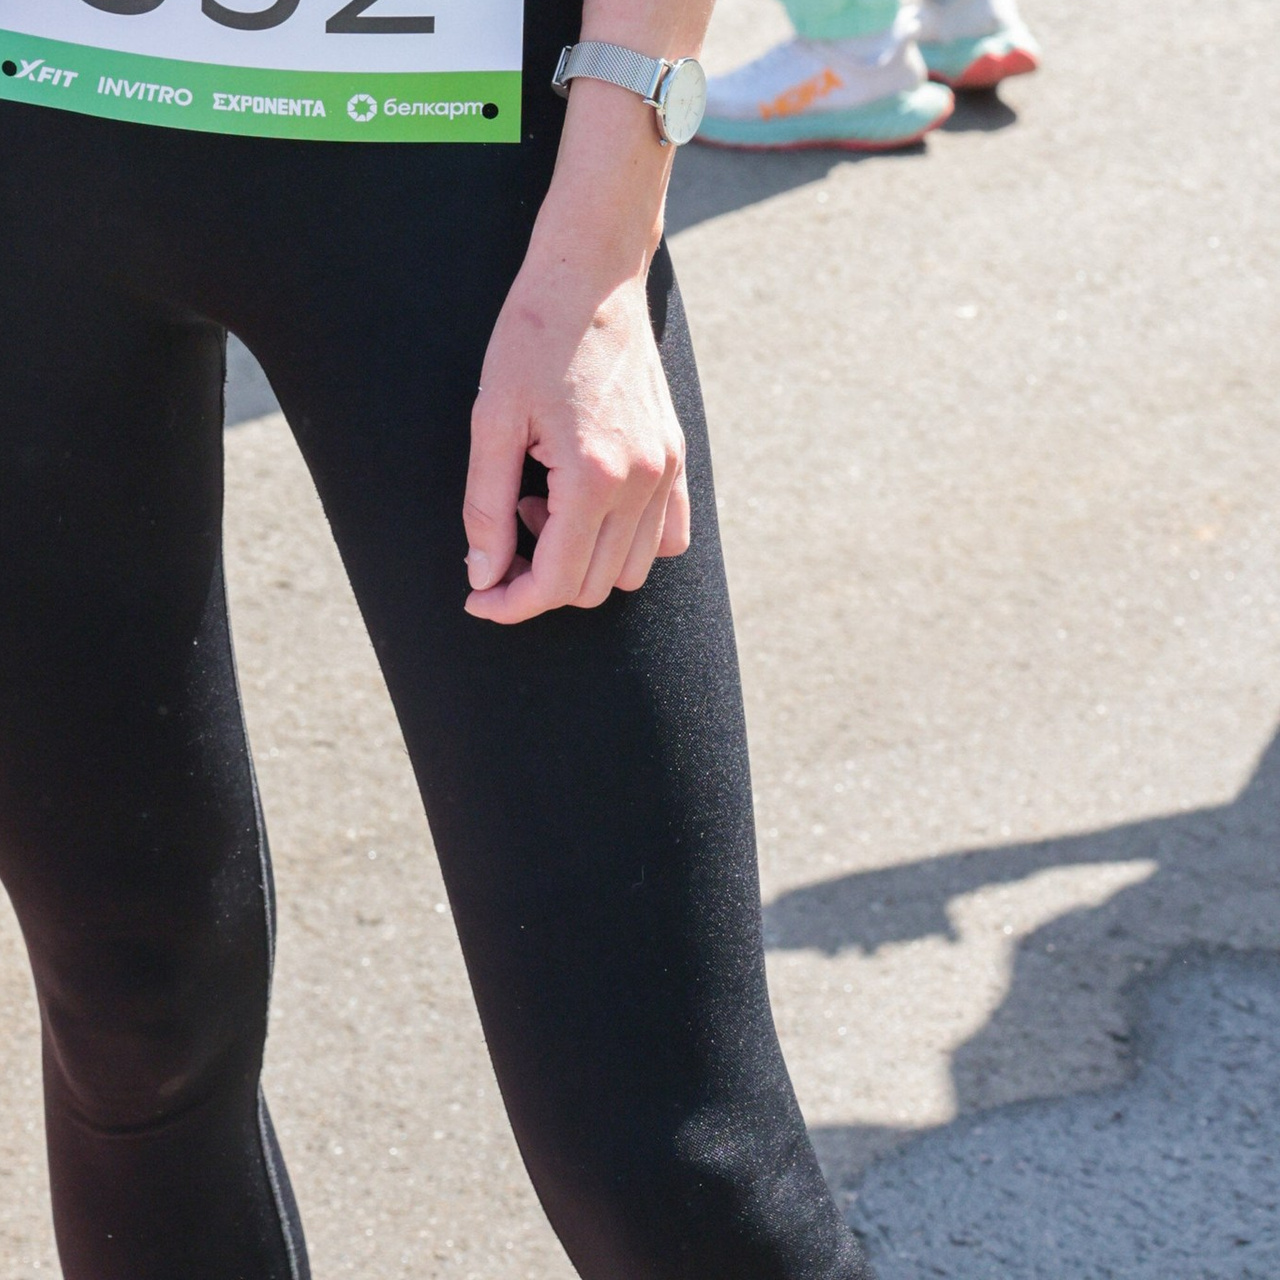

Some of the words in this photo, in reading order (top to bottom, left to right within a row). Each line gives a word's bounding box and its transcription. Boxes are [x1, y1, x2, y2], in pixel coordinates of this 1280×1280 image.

[15, 58, 78, 88] XFIT
[97, 76, 193, 106] INVITRO
[384, 98, 483, 120] белкарт
